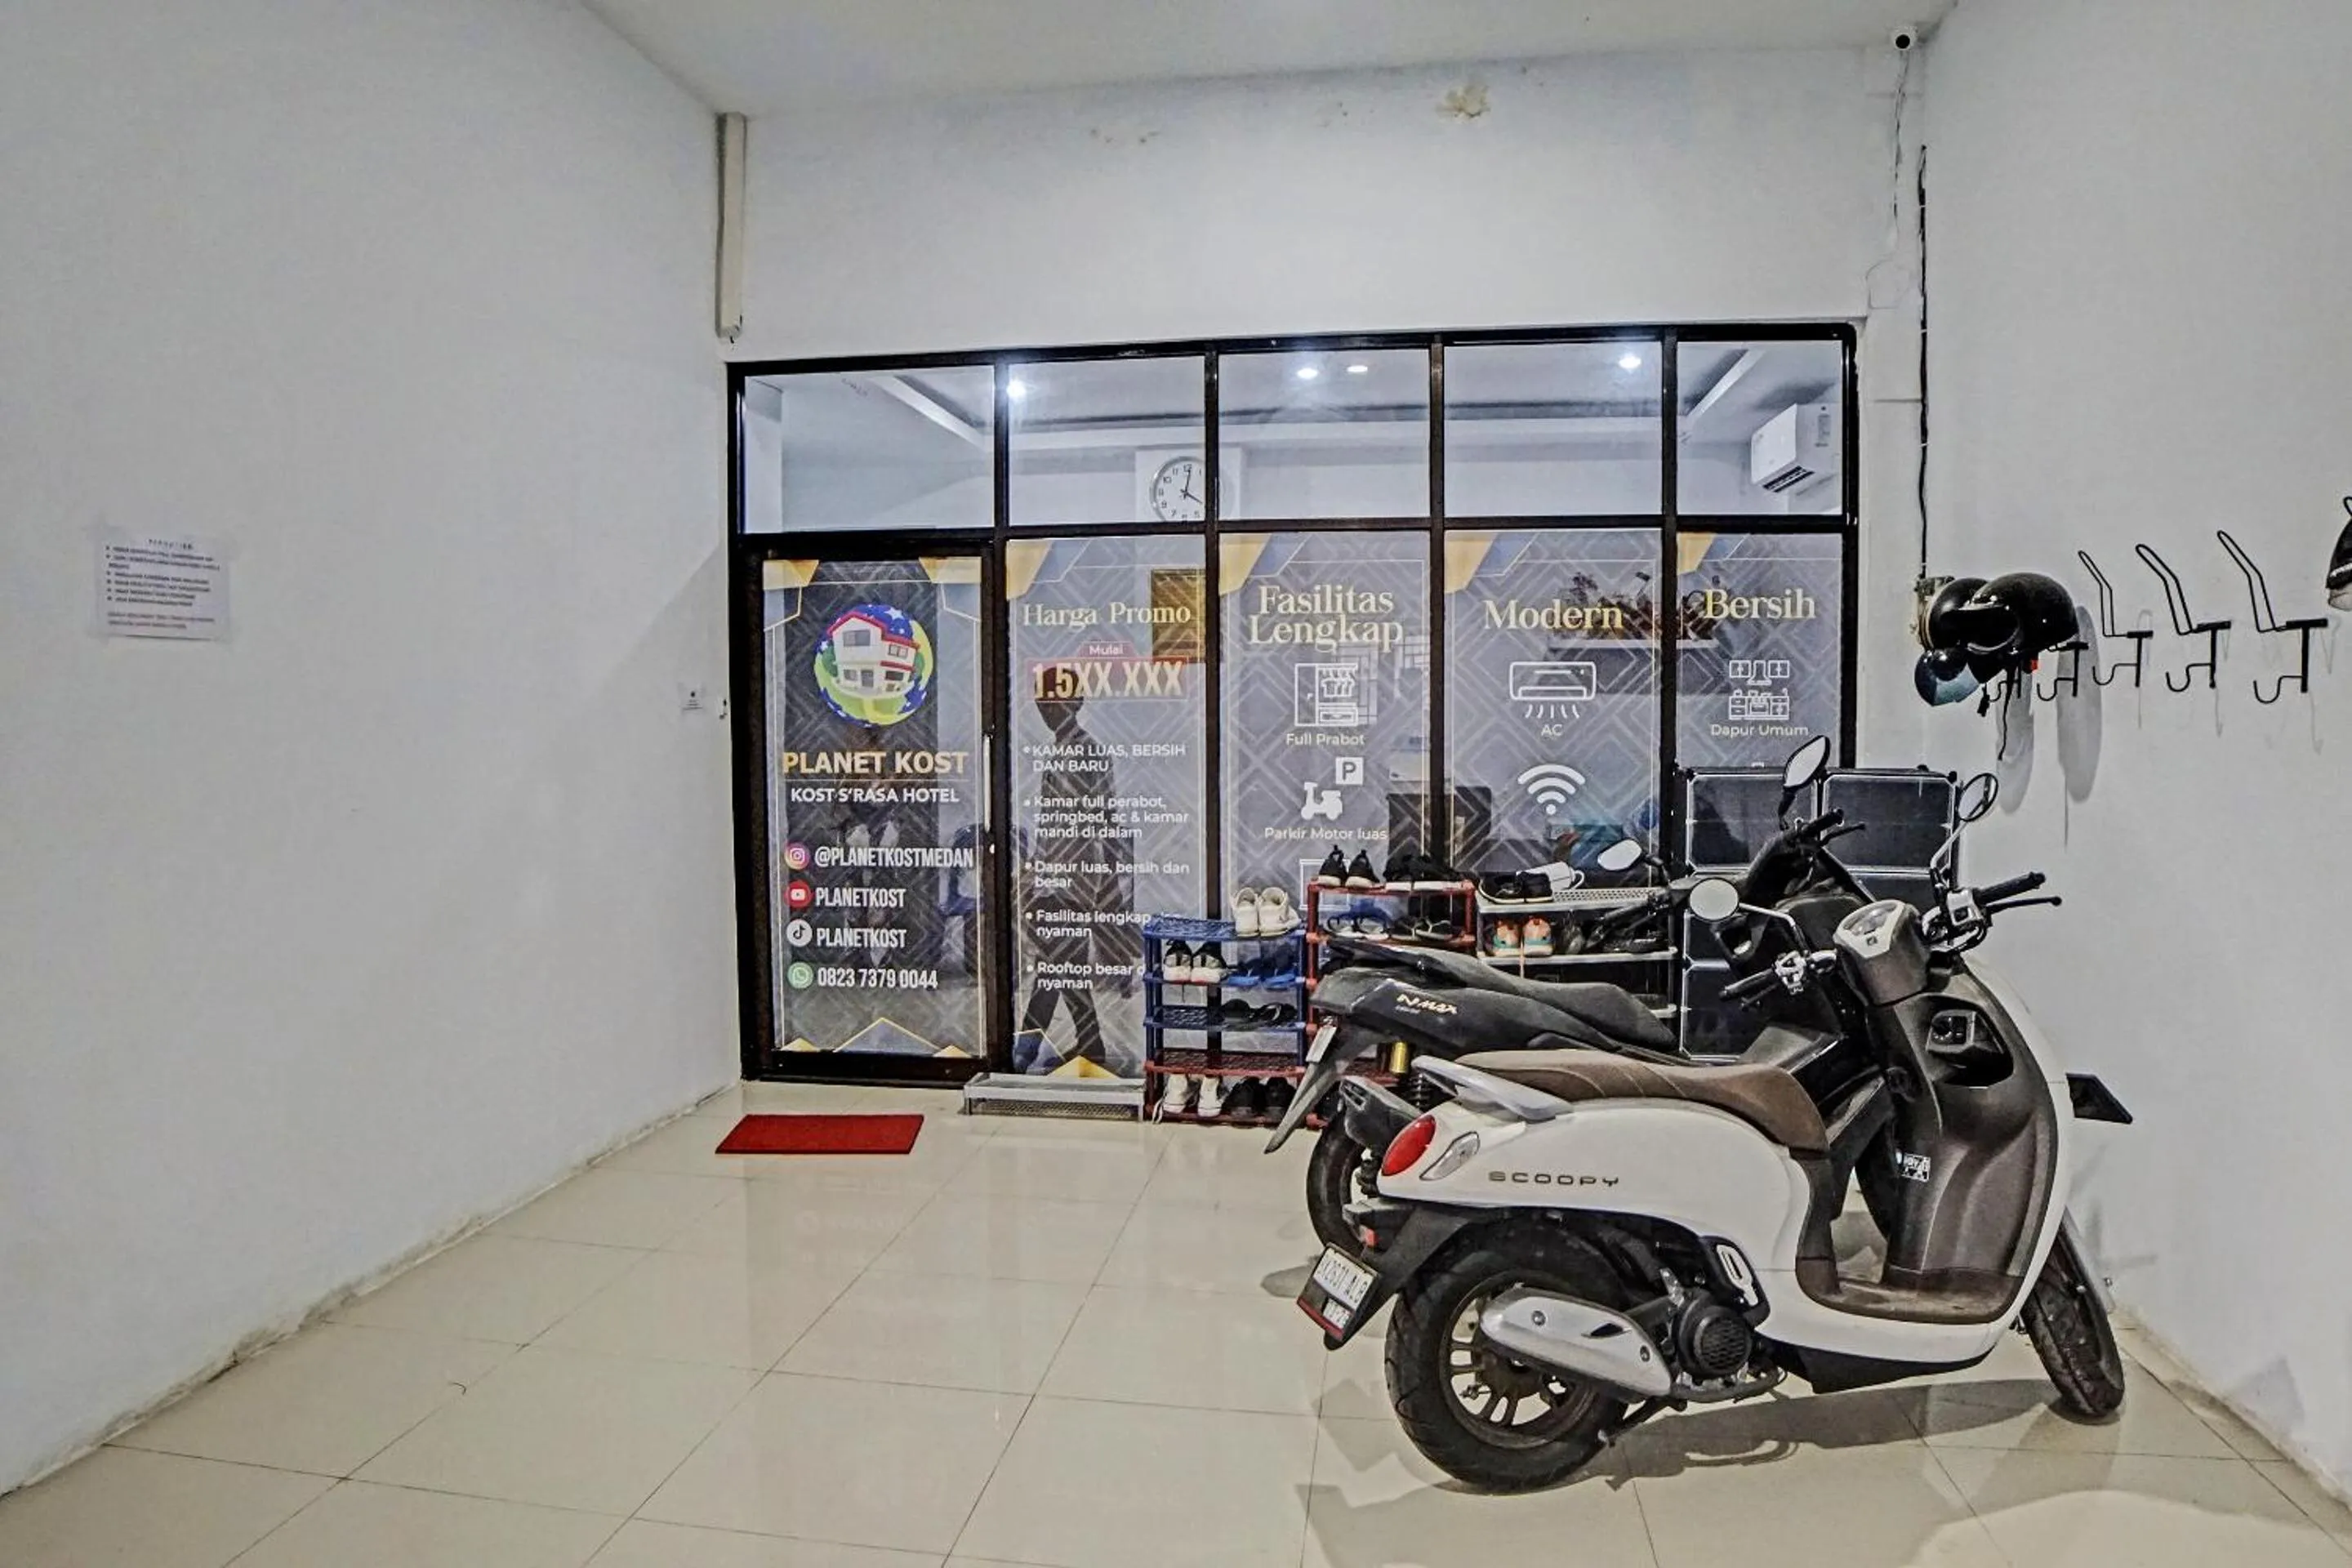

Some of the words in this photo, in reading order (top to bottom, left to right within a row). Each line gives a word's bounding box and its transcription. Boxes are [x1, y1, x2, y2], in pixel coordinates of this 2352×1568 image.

[1258, 584, 1395, 613] Fasilitas
[1704, 588, 1816, 619] Bersih
[1023, 602, 1098, 630] Harga
[1110, 601, 1191, 624] Promo
[1483, 599, 1624, 630] Modern
[1249, 614, 1403, 653] Lengkap
[1089, 644, 1125, 655] Mulai
[1032, 660, 1183, 698] 1.5XX.XXX
[1541, 724, 1564, 736] AC
[1711, 724, 1754, 738] Dapur
[1758, 724, 1808, 736] Umum
[1286, 733, 1312, 746] Full
[1316, 733, 1365, 746] Prabot
[1032, 745, 1085, 757] KAMAR
[1088, 744, 1129, 759] LUAS,
[1133, 744, 1186, 757] BERSIH
[782, 751, 887, 775] PLANET
[894, 751, 969, 775] KOST
[1033, 760, 1064, 772] DAN
[1068, 760, 1109, 773] BARU
[791, 787, 838, 803] KOST
[902, 787, 960, 803] HOTEL
[1034, 795, 1080, 808] Kamar
[1082, 795, 1104, 808] full
[1108, 795, 1167, 811] perabot,
[1034, 810, 1108, 825] springbed,
[1111, 813, 1127, 823] ac
[1130, 811, 1140, 823] &
[1143, 810, 1189, 823] kamar
[1034, 826, 1078, 839] mandi
[1081, 826, 1096, 839] di
[1098, 826, 1143, 839] dalam
[1265, 826, 1307, 840] Parkir
[1311, 826, 1353, 840] Motor
[1357, 826, 1388, 840] luas
[815, 846, 973, 868] @PLANETKOSTMEDAN
[1035, 860, 1078, 876] Dapur
[1080, 860, 1112, 875] luas,
[1116, 860, 1159, 874] bersih
[1162, 861, 1190, 875] dan
[1035, 876, 1073, 889] besar
[816, 887, 906, 908] PLANETKOST
[1036, 909, 1091, 923] Fasilitas
[1094, 910, 1152, 927] lengkap
[817, 928, 906, 948] PLANETKOST
[1036, 926, 1092, 938] nyaman
[1037, 961, 1093, 978] Rooftop
[1095, 961, 1134, 975] besar
[817, 967, 856, 988] 0823
[859, 968, 897, 989] 7379
[899, 969, 938, 990] 0044
[1037, 978, 1094, 991] nyaman
[1488, 1169, 1619, 1188] SCOOPY
